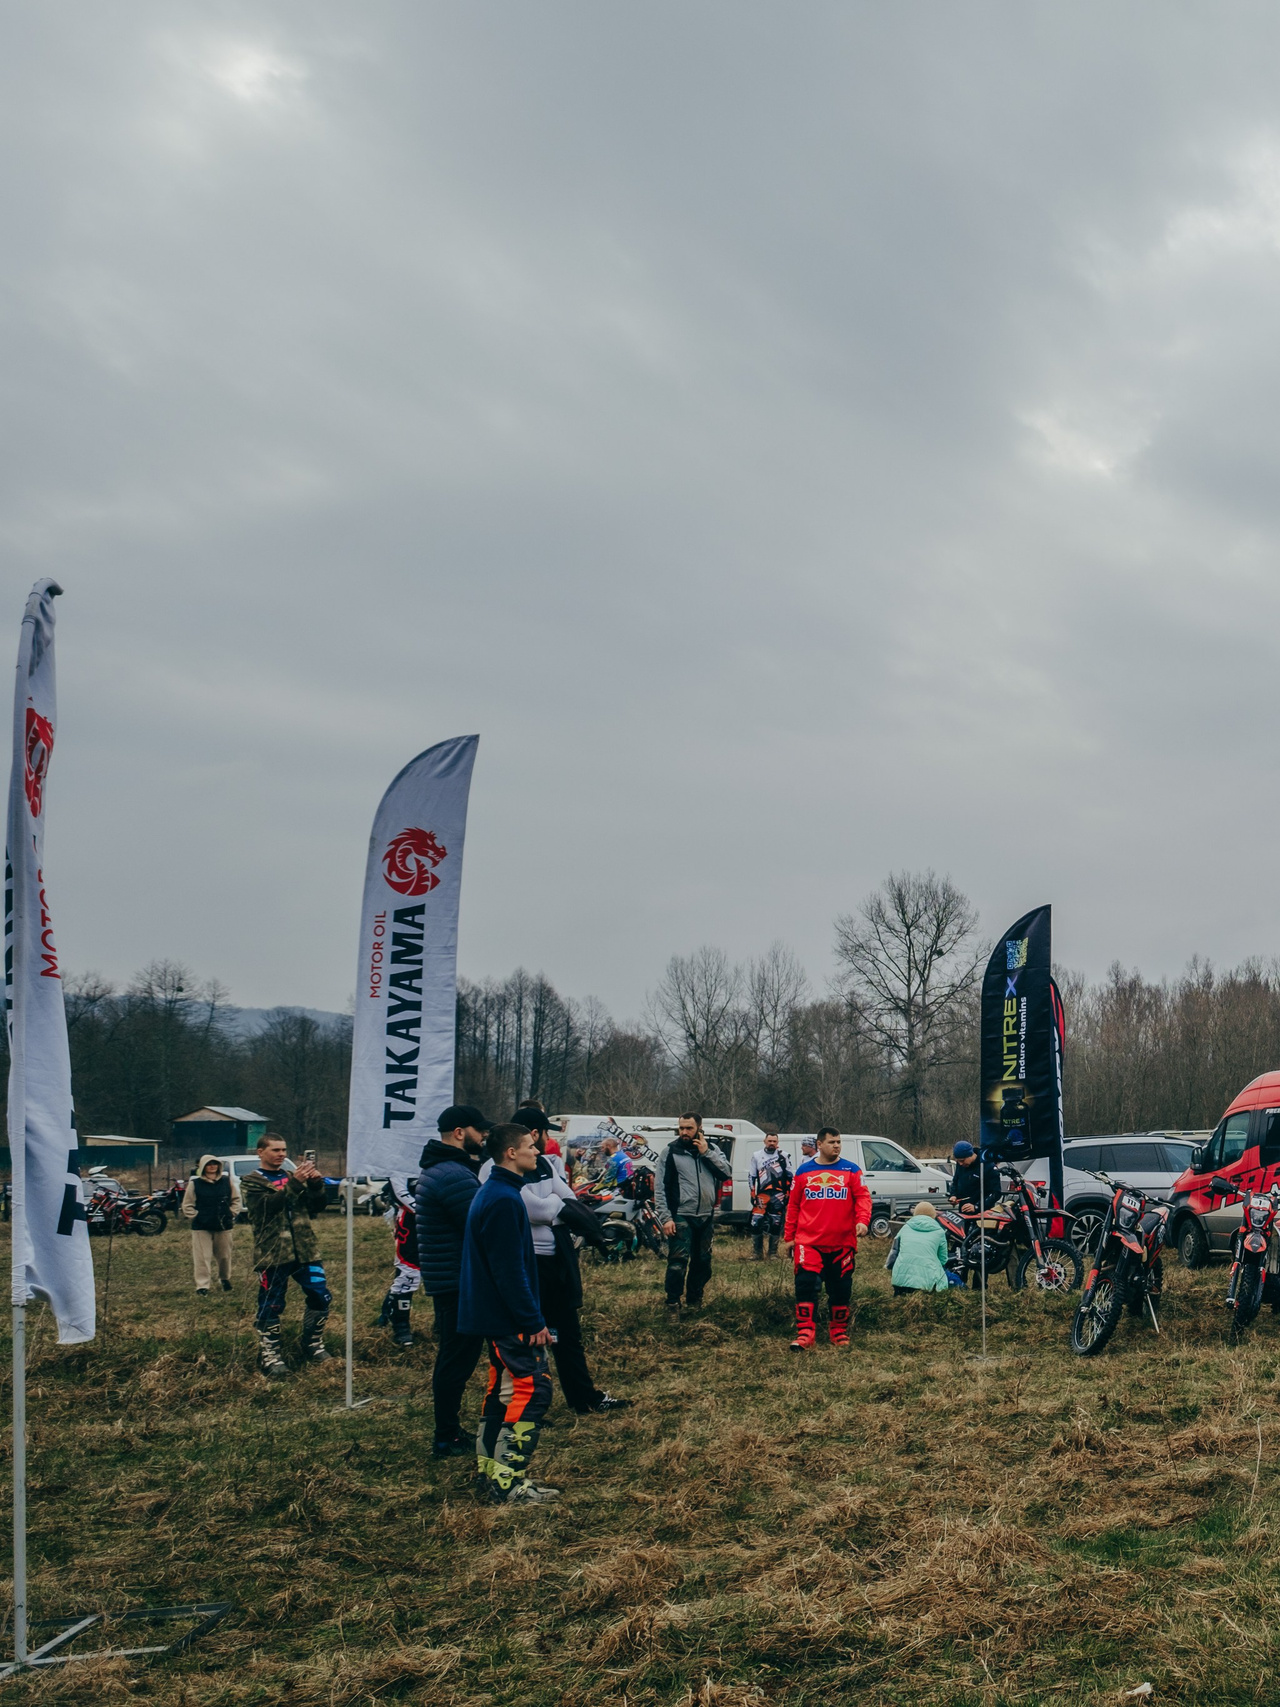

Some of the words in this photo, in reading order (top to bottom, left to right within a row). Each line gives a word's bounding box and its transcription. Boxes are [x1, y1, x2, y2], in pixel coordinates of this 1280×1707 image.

[373, 910, 387, 937] OIL
[369, 941, 385, 998] MOTOR
[382, 903, 426, 1129] TAKAYAMA
[1002, 974, 1018, 1081] NITREX
[1018, 996, 1027, 1040] vitamins
[1019, 1042, 1027, 1080] Enduro
[609, 1124, 638, 1147] START
[804, 1187, 825, 1200] Red
[826, 1188, 848, 1199] Bull
[1127, 1198, 1137, 1207] 111
